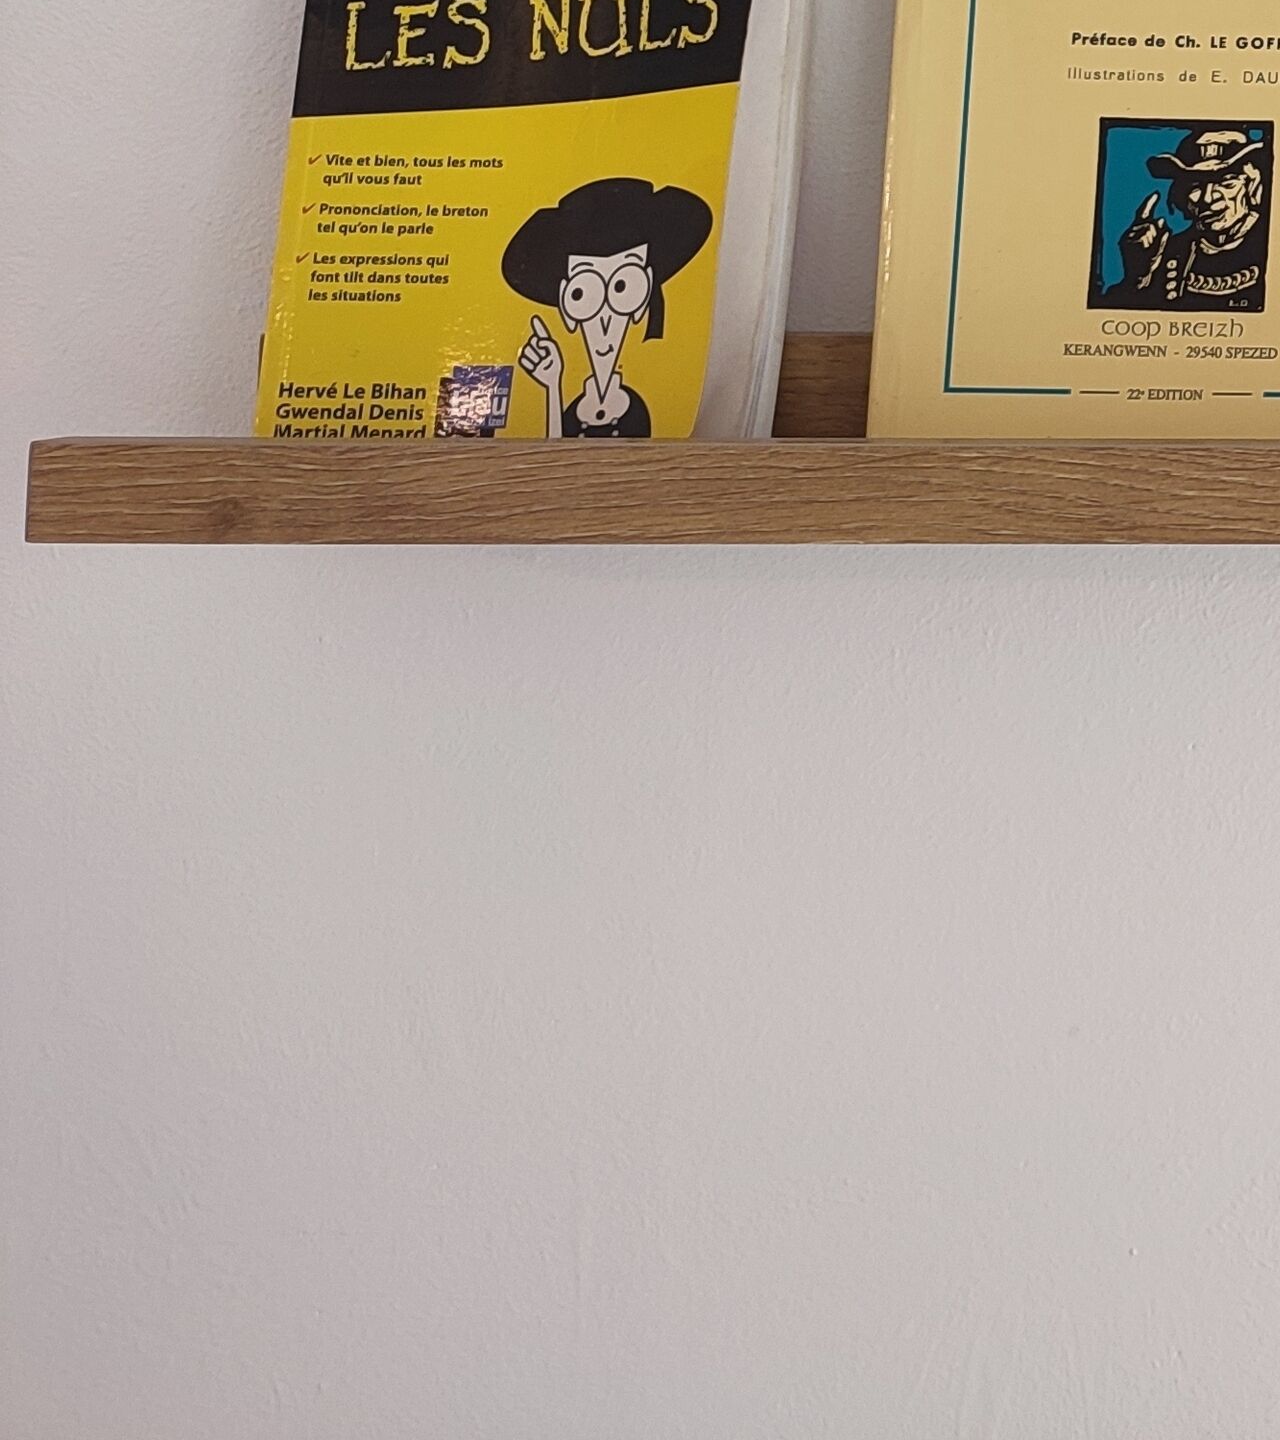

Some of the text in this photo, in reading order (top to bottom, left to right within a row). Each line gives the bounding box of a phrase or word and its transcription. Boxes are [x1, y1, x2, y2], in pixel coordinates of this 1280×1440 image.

[1071, 32, 1137, 46] Préface
[1144, 35, 1166, 47] de
[1175, 35, 1200, 48] Ch.
[1210, 36, 1227, 48] LE
[1067, 68, 1165, 82] Illustrations
[1178, 70, 1197, 82] de
[1211, 71, 1227, 83] E.
[326, 154, 504, 168] Vite et bien, tous les mots
[357, 175, 390, 185] vous
[393, 174, 422, 185] faut
[319, 203, 489, 217] Prononciation, le breton
[317, 222, 335, 233] tel
[381, 222, 394, 234] le
[397, 223, 434, 237] parle
[313, 252, 450, 268] Les expressions qui
[310, 271, 449, 284] font tilt dans toutes
[308, 289, 402, 302] les situations
[1063, 344, 1168, 357] KERANGWENN
[1186, 346, 1222, 359] 29540
[1225, 346, 1278, 360] SPEZED
[278, 382, 427, 400] Hervé Le Bihan
[1148, 389, 1204, 401] EDITION
[276, 403, 424, 421] Gwendal Denis
[273, 423, 345, 438] Martial
